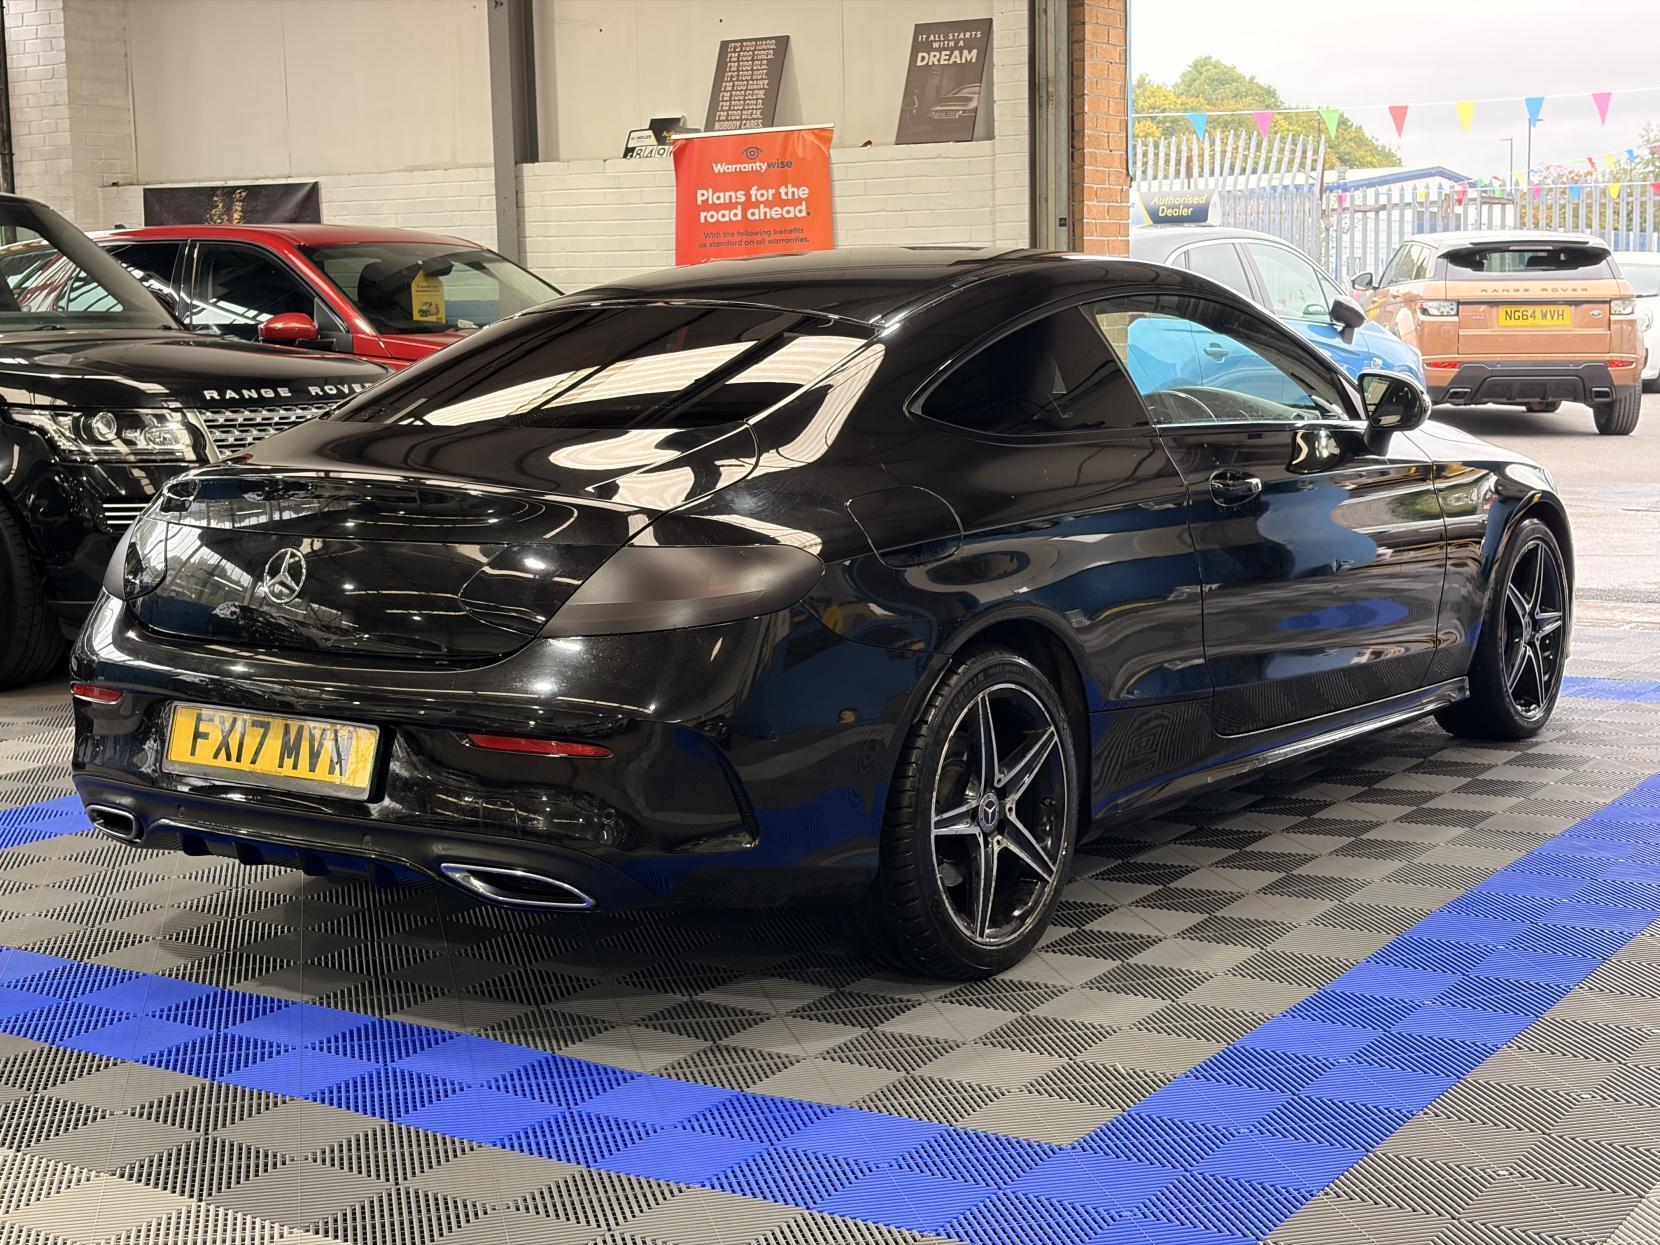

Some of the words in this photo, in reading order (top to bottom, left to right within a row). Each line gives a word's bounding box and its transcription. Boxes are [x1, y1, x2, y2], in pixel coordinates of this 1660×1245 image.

[948, 31, 982, 39] STARTS
[728, 43, 741, 52] IT'S
[743, 42, 756, 51] TOO
[757, 40, 776, 49] HARD.
[727, 53, 738, 62] I'M
[740, 52, 752, 61] TOO
[754, 51, 774, 59] TIRED.
[916, 49, 978, 65] DREAM
[727, 63, 738, 72] I'M
[740, 62, 752, 71] TOO
[753, 61, 767, 69] OLD.
[725, 73, 738, 82] IT'S
[739, 72, 752, 80] TOO
[753, 71, 767, 79] HOT.
[722, 83, 733, 91] I'M
[734, 82, 747, 90] TOO
[720, 93, 731, 101] I'M
[732, 92, 745, 100] TOO
[719, 102, 730, 111] I'M
[731, 102, 744, 110] TOO
[716, 112, 728, 121] I'M
[728, 112, 741, 120] TOO
[742, 110, 762, 118] WEAK.
[715, 122, 741, 131] NOBODY
[712, 158, 793, 174] Warrantywise
[696, 188, 746, 205] Plans
[749, 186, 776, 201] for
[778, 183, 810, 200] the
[1150, 193, 1207, 206] Authorised
[699, 205, 742, 224] road
[746, 201, 811, 220] ahead.
[1158, 205, 1194, 217] Dealer
[703, 231, 721, 239] With
[722, 230, 735, 238] the
[736, 228, 772, 237] following
[773, 227, 805, 235] benefits
[708, 239, 743, 248] standard
[756, 238, 766, 246] all
[1504, 309, 1537, 321] NG64
[1540, 308, 1565, 321] WVH
[203, 387, 292, 400] RANGE
[190, 712, 271, 765] FX17
